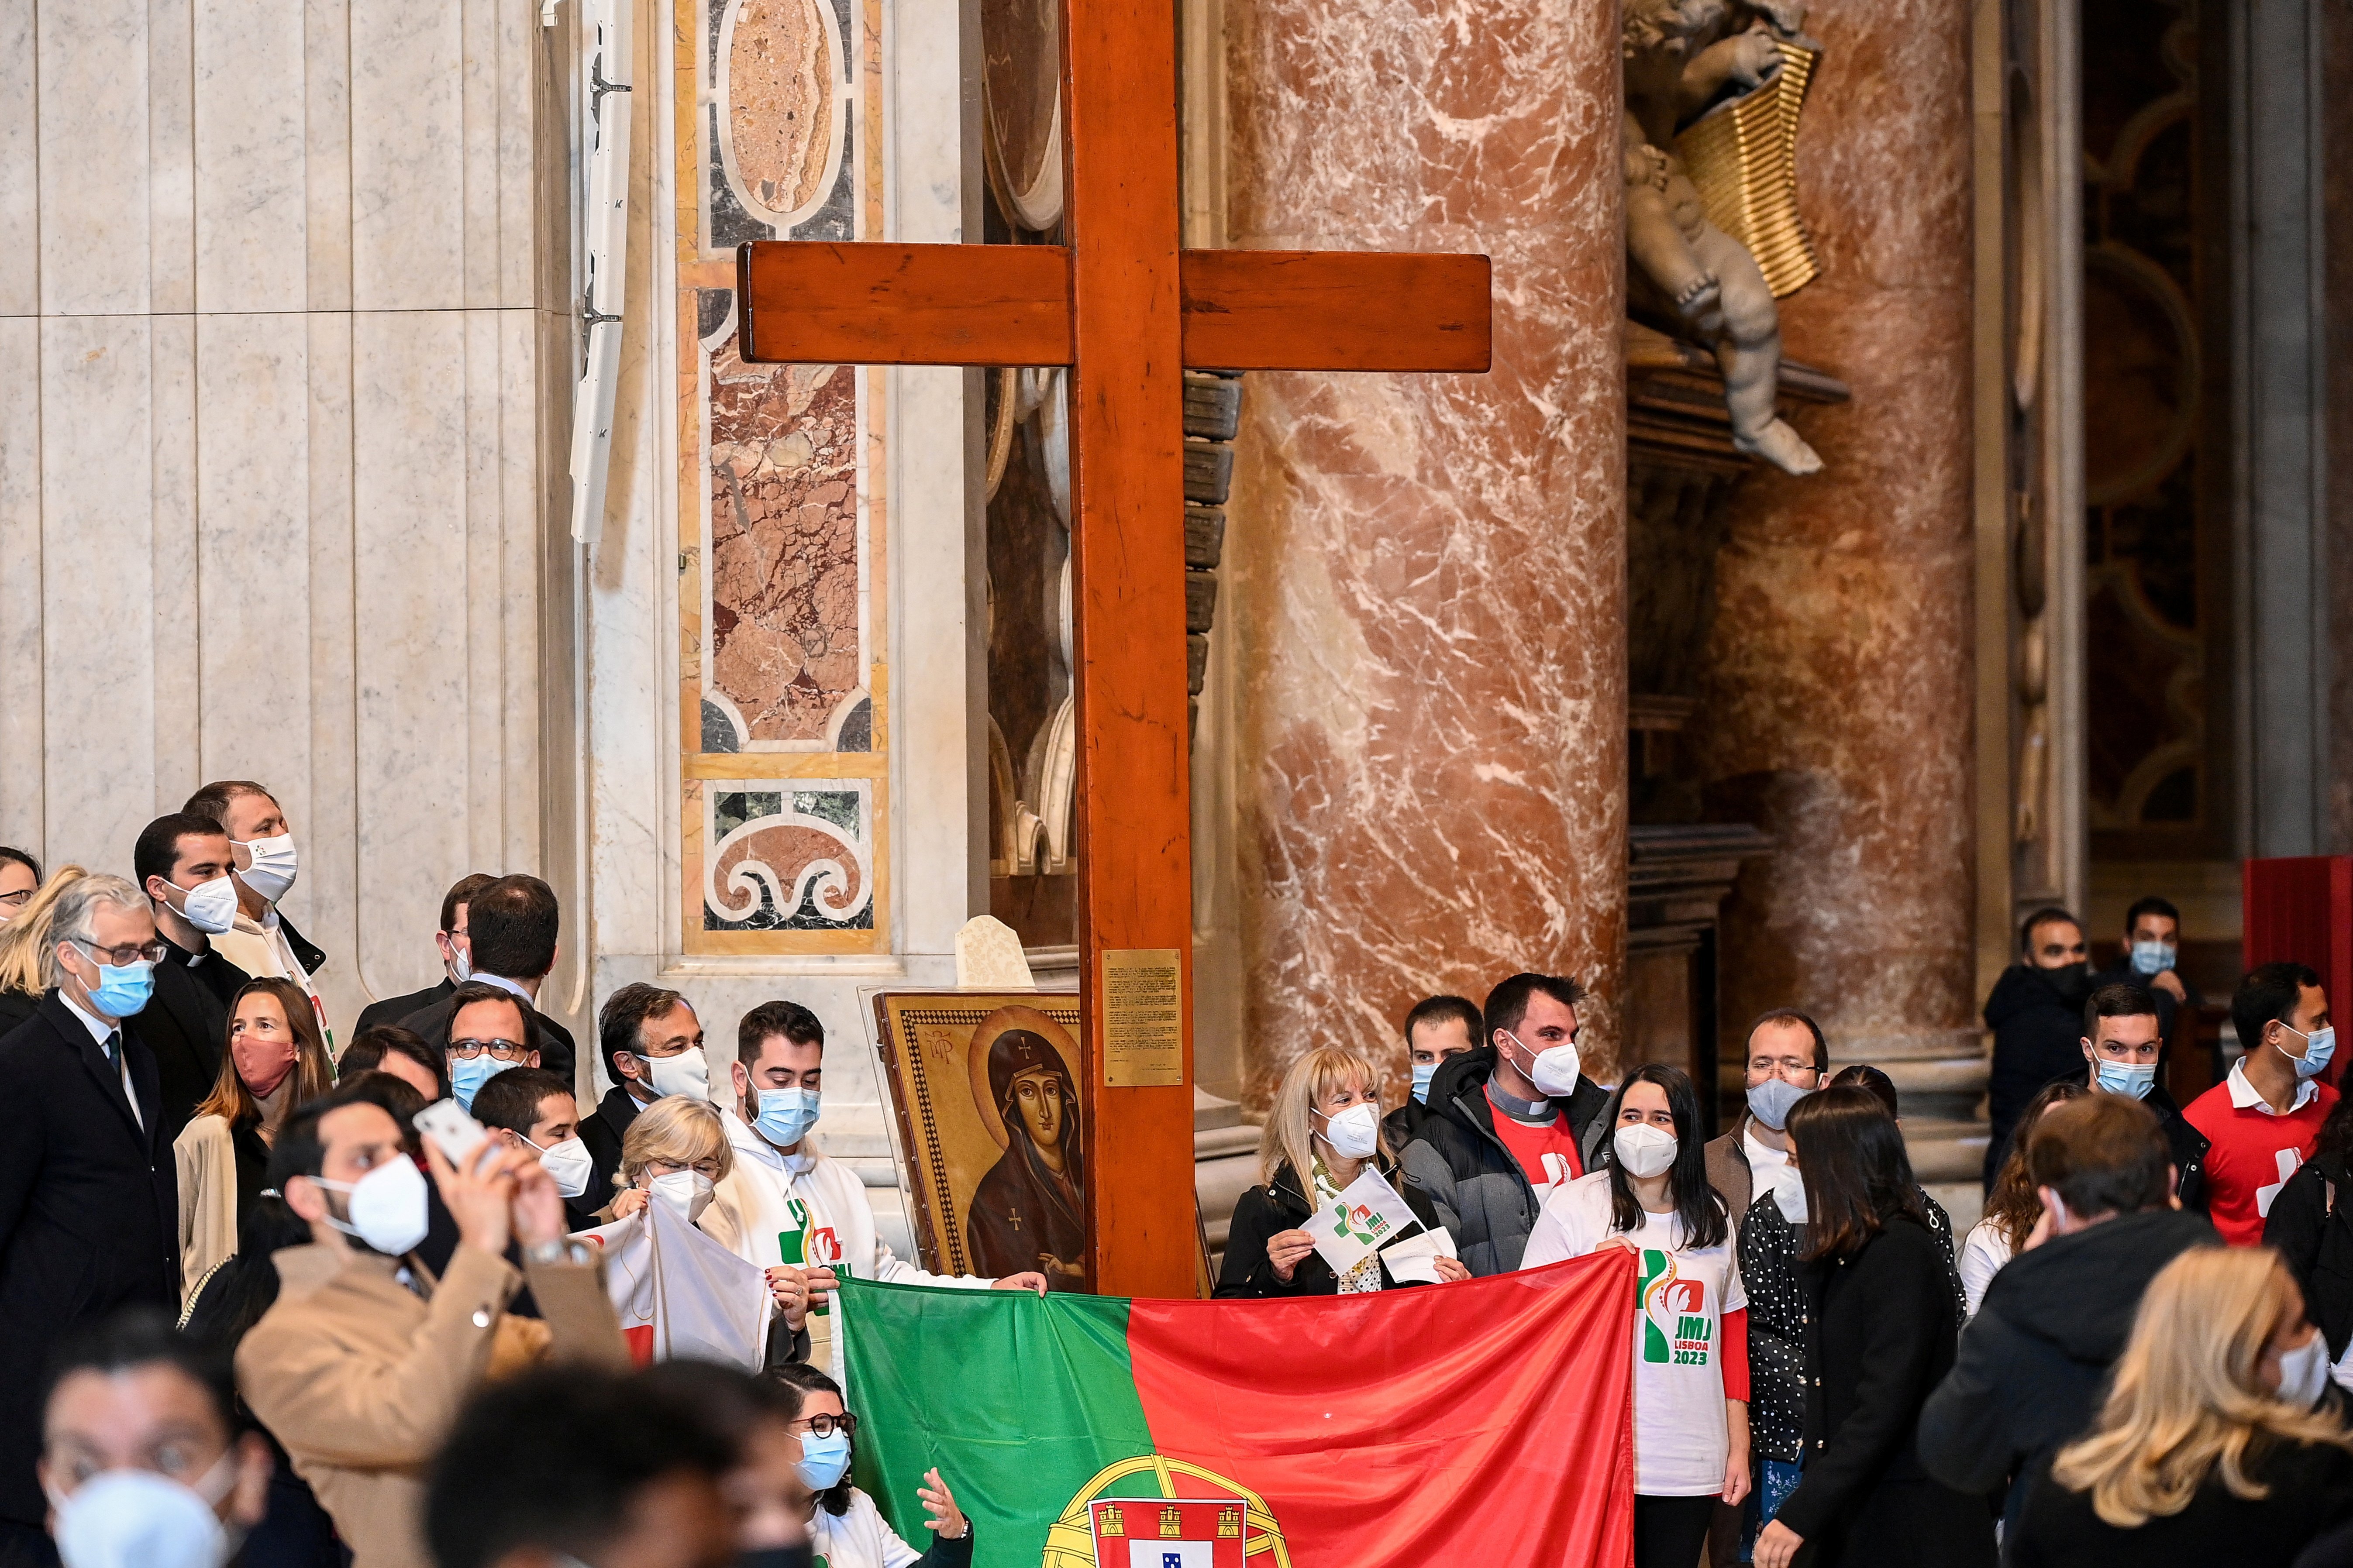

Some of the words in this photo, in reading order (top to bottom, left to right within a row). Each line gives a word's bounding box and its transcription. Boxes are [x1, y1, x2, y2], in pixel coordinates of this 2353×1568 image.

[615, 199, 623, 208] K
[599, 429, 607, 437] K
[1365, 1212, 1383, 1230] JMJ
[1371, 1221, 1387, 1233] LISBOA
[1374, 1224, 1390, 1238] 2023
[1675, 1316, 1712, 1341] JMJ
[1674, 1340, 1708, 1351] LISBOA
[1674, 1350, 1707, 1365] 2023
